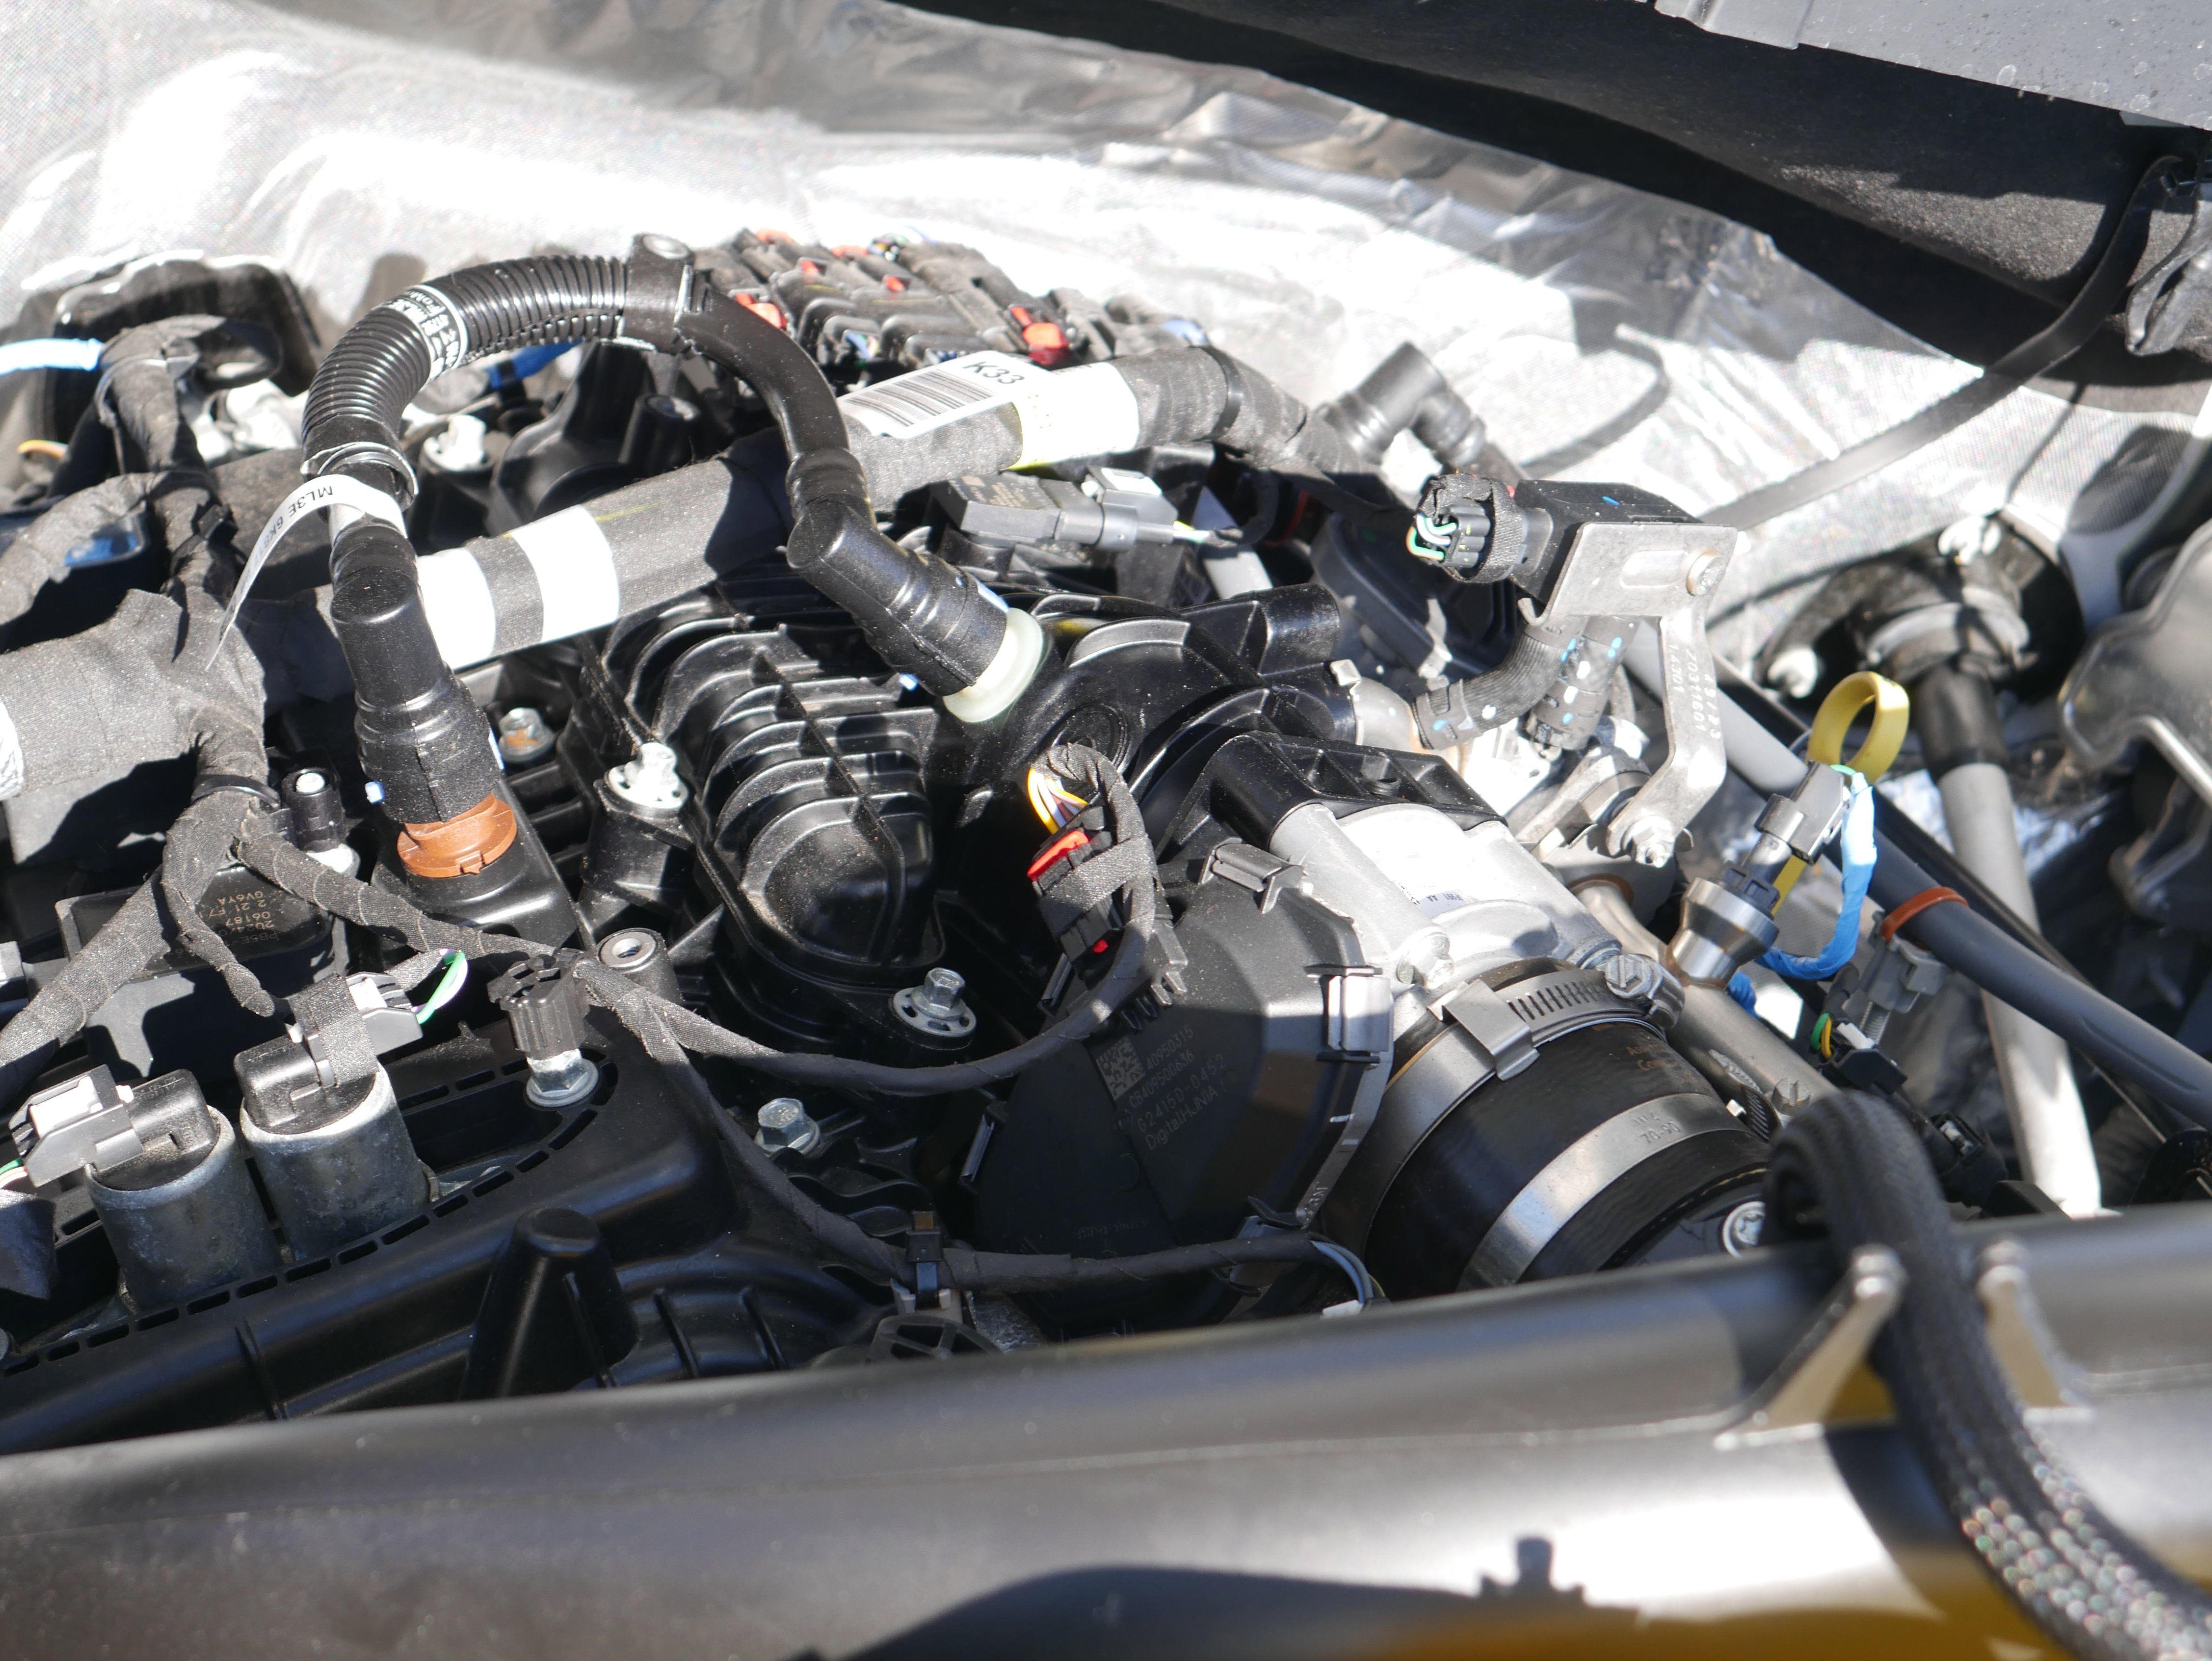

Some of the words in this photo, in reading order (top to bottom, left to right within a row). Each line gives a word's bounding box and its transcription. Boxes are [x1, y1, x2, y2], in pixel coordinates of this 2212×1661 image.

[962, 361, 1025, 384] K33
[288, 486, 333, 518] ML3E
[1640, 1121, 1680, 1144] 70-90
